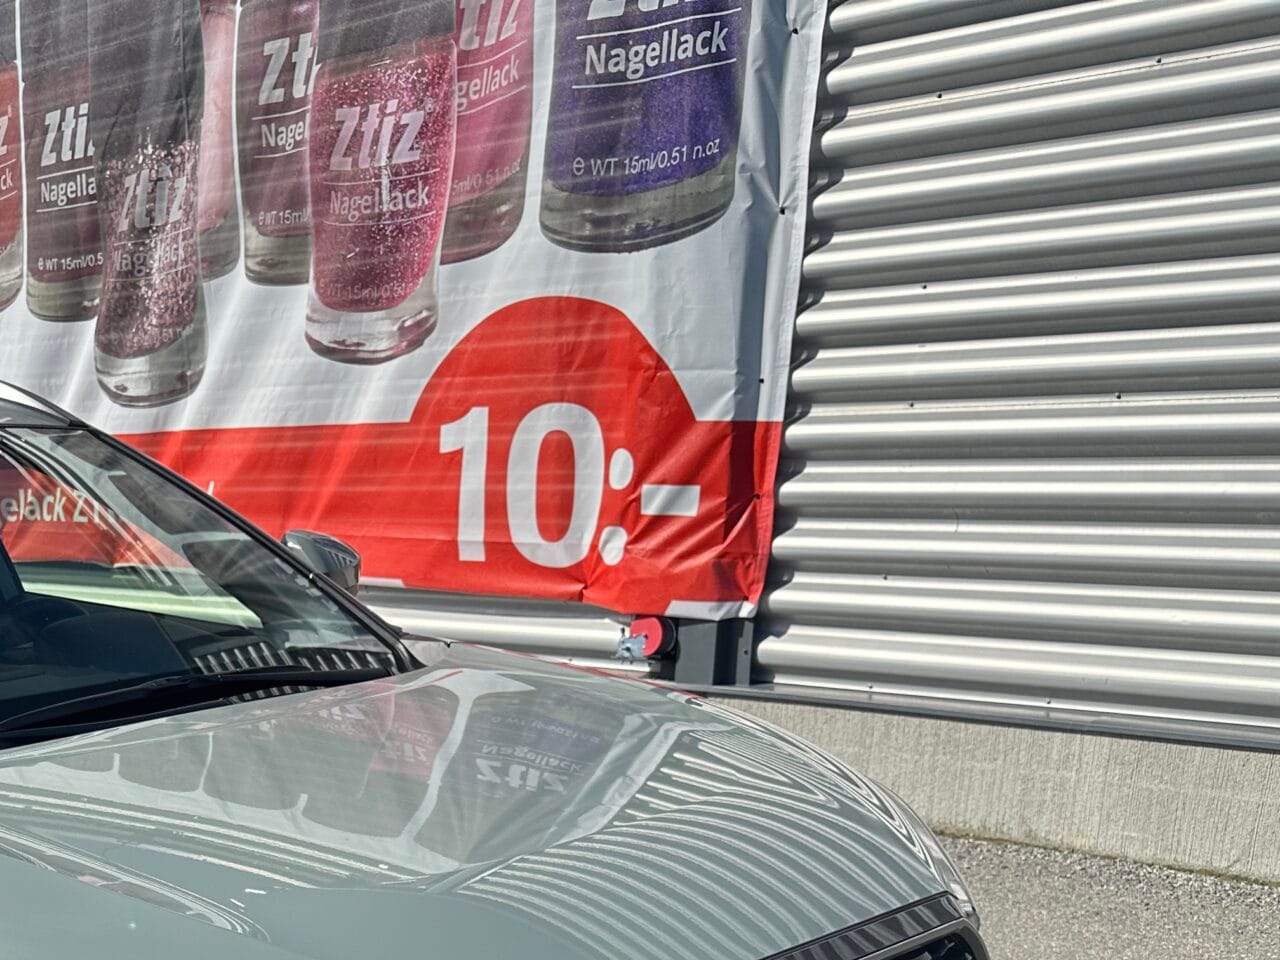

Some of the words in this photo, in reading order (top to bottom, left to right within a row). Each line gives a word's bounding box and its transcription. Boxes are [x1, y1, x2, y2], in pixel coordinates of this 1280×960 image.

[585, 21, 728, 79] Nagellack
[329, 99, 425, 171] Ztiz
[590, 159, 618, 176] WT
[624, 145, 687, 174] 15ml/0.51
[118, 165, 187, 232] Ztiz
[330, 178, 430, 222] Nagellack
[439, 402, 701, 568] 10:-
